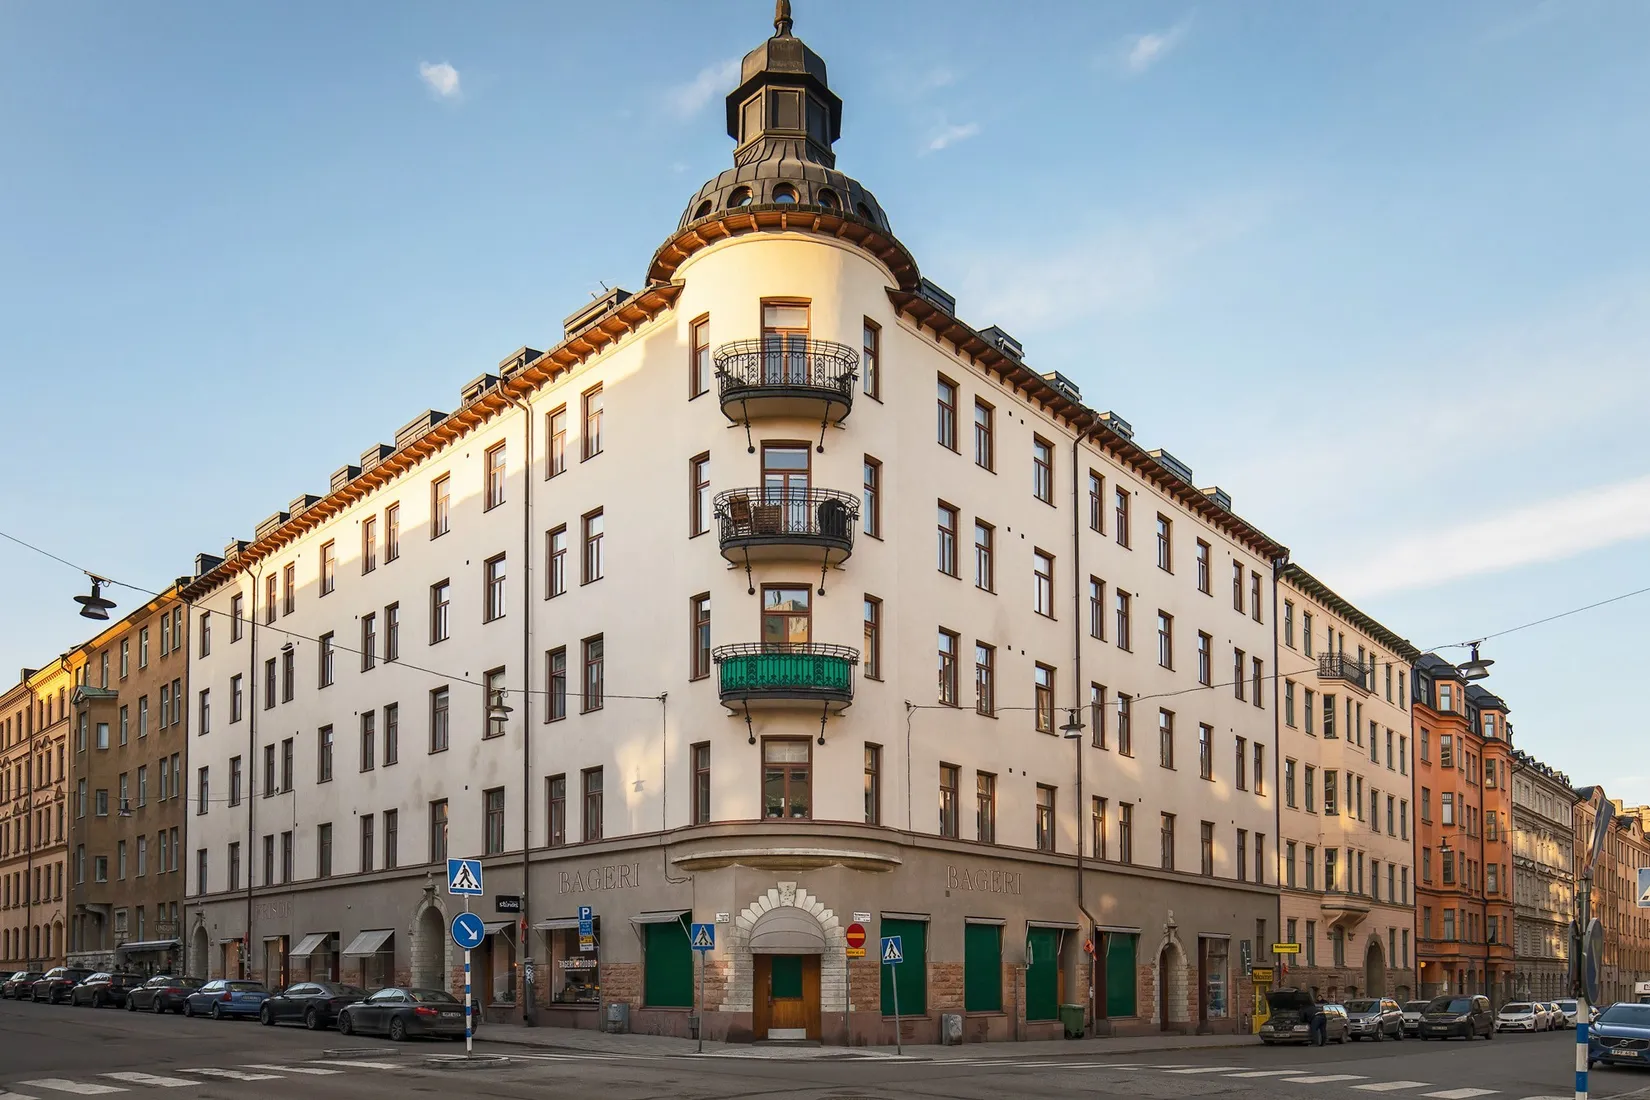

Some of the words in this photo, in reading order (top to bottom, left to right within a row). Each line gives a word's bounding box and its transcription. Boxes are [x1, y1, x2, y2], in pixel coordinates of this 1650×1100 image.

[557, 863, 640, 895] BAGERI
[946, 865, 1022, 895] BAGERI
[581, 907, 590, 920] P
